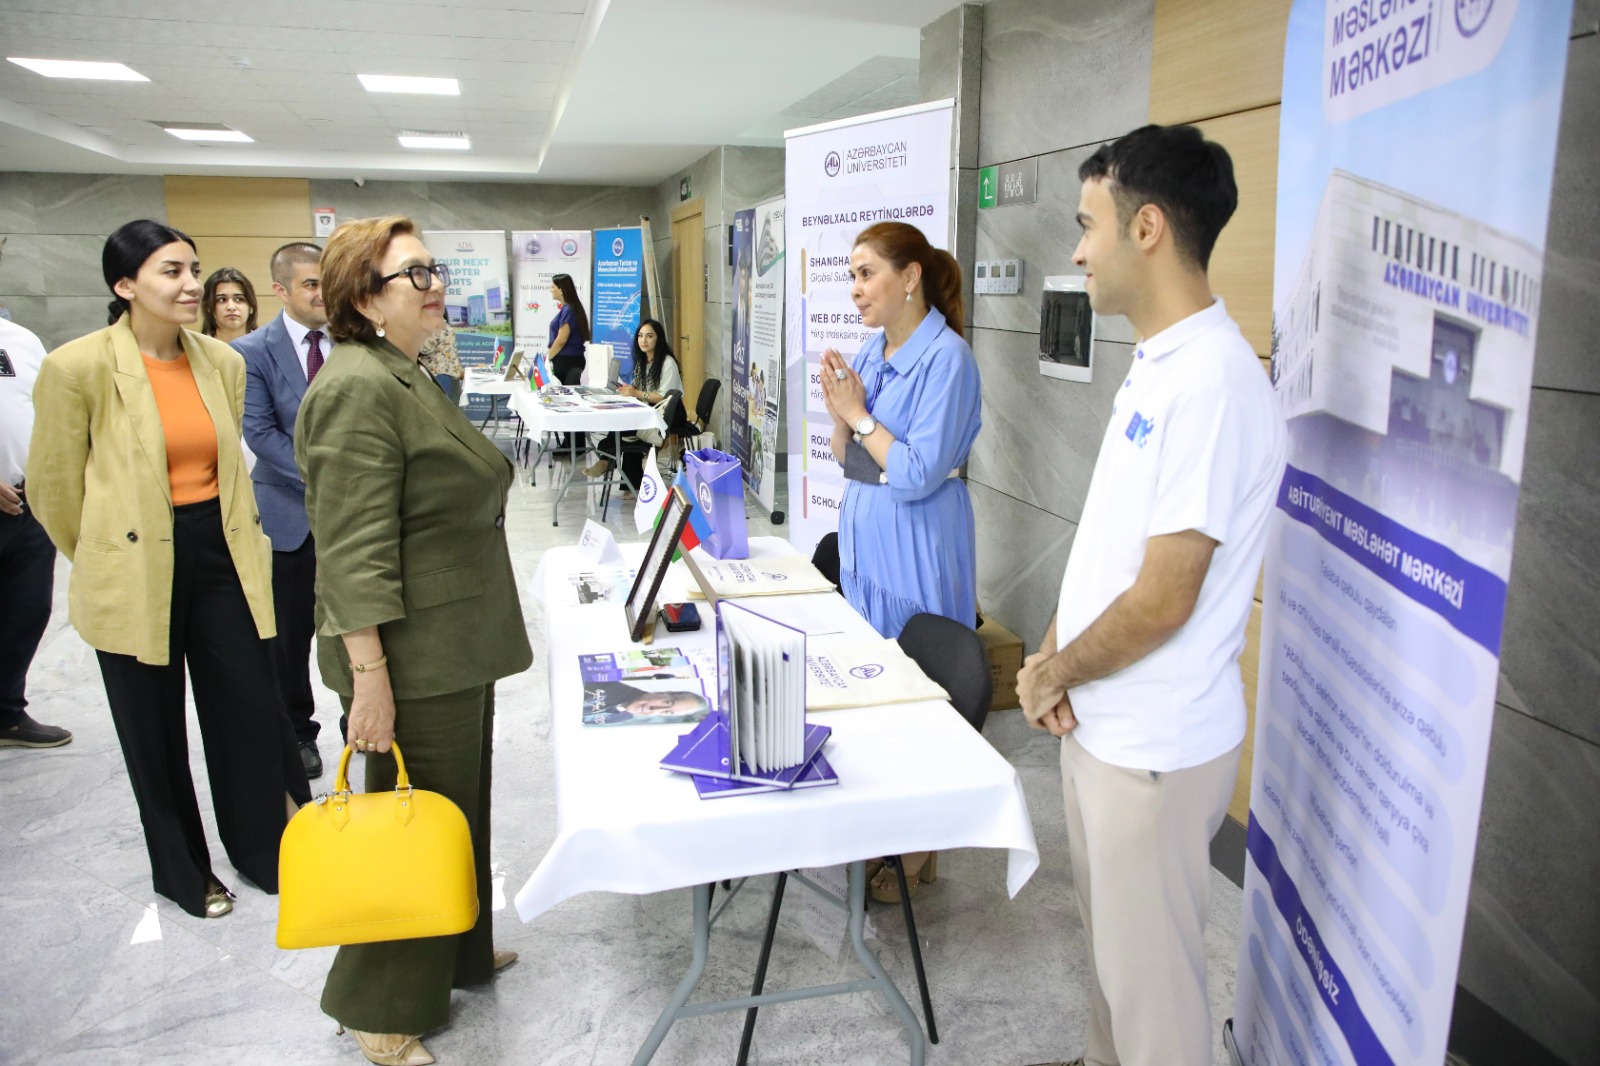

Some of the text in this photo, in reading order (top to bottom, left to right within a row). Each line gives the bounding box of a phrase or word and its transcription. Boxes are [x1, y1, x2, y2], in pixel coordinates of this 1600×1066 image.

[1332, 0, 1417, 47] MƏSLƏ
[1329, 1, 1432, 98] MƏRKƏZİ
[846, 141, 907, 160] AZƏRBAYCAN
[847, 155, 907, 174] UNİVERSİTETİ
[802, 211, 858, 227] BEYNƏLXALQ
[859, 205, 934, 221] REYTİNQLƏRDƏ
[463, 258, 489, 266] NEXT
[810, 256, 850, 267] SHANGHA
[449, 268, 481, 276] APTER
[445, 287, 462, 295] ERE
[811, 314, 862, 324] WEB OF SCIE
[860, 331, 875, 342] gör
[811, 435, 831, 446] ROU
[812, 495, 842, 510] SCHOLA
[1288, 485, 1465, 610] ABİTURİYENT MƏSLƏHƏT MƏRKƏZİ
